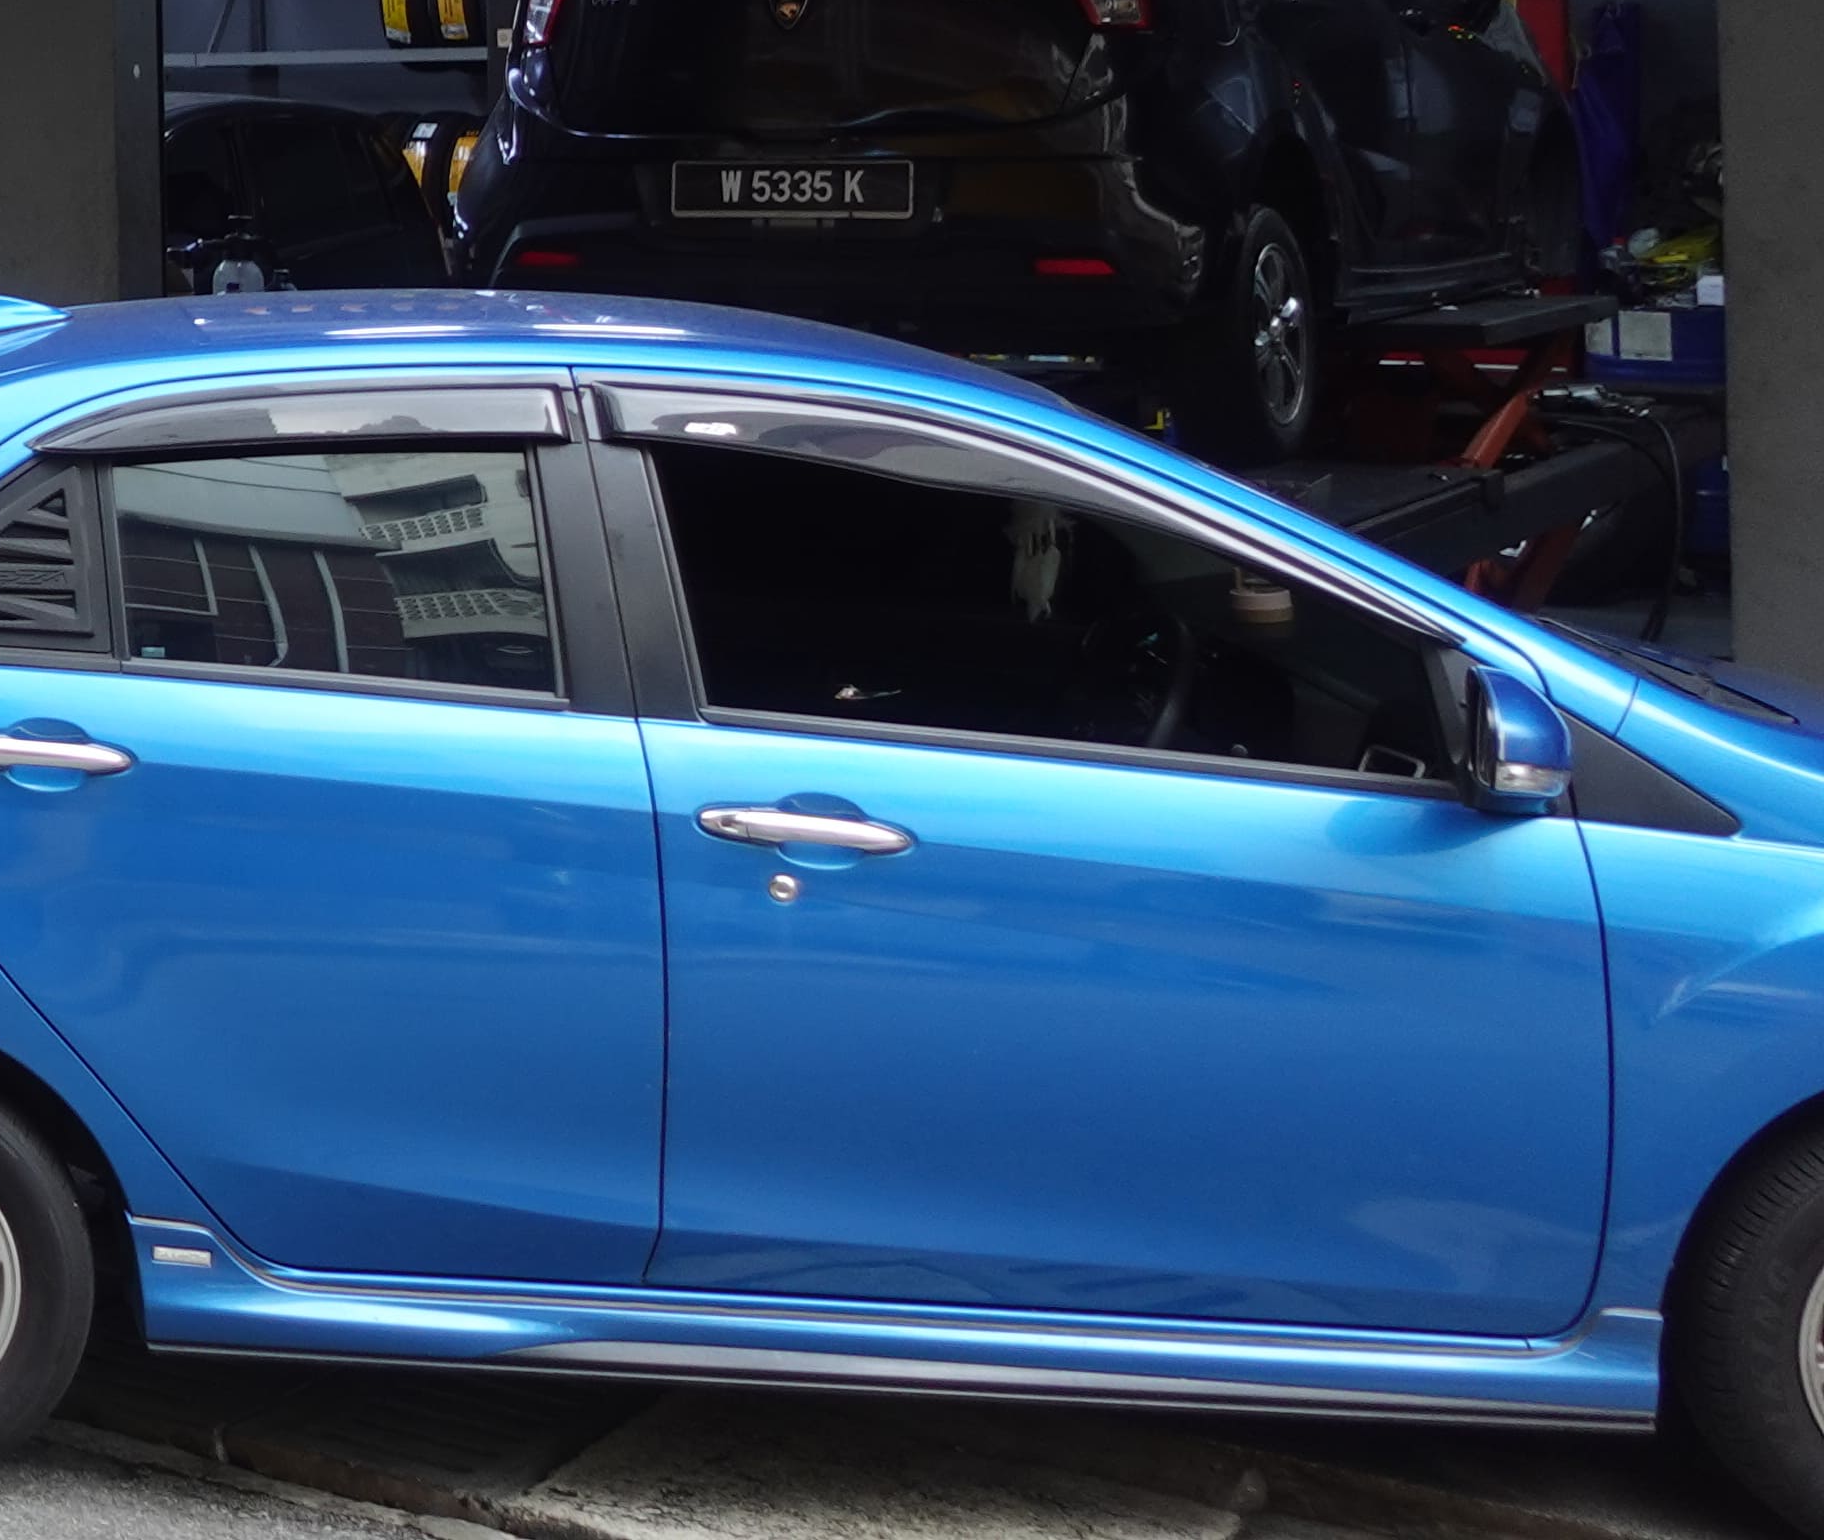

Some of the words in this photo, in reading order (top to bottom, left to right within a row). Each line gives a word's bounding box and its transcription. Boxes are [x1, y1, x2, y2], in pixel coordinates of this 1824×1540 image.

[720, 170, 742, 203] W
[751, 170, 833, 203] 5335
[843, 170, 865, 203] K
